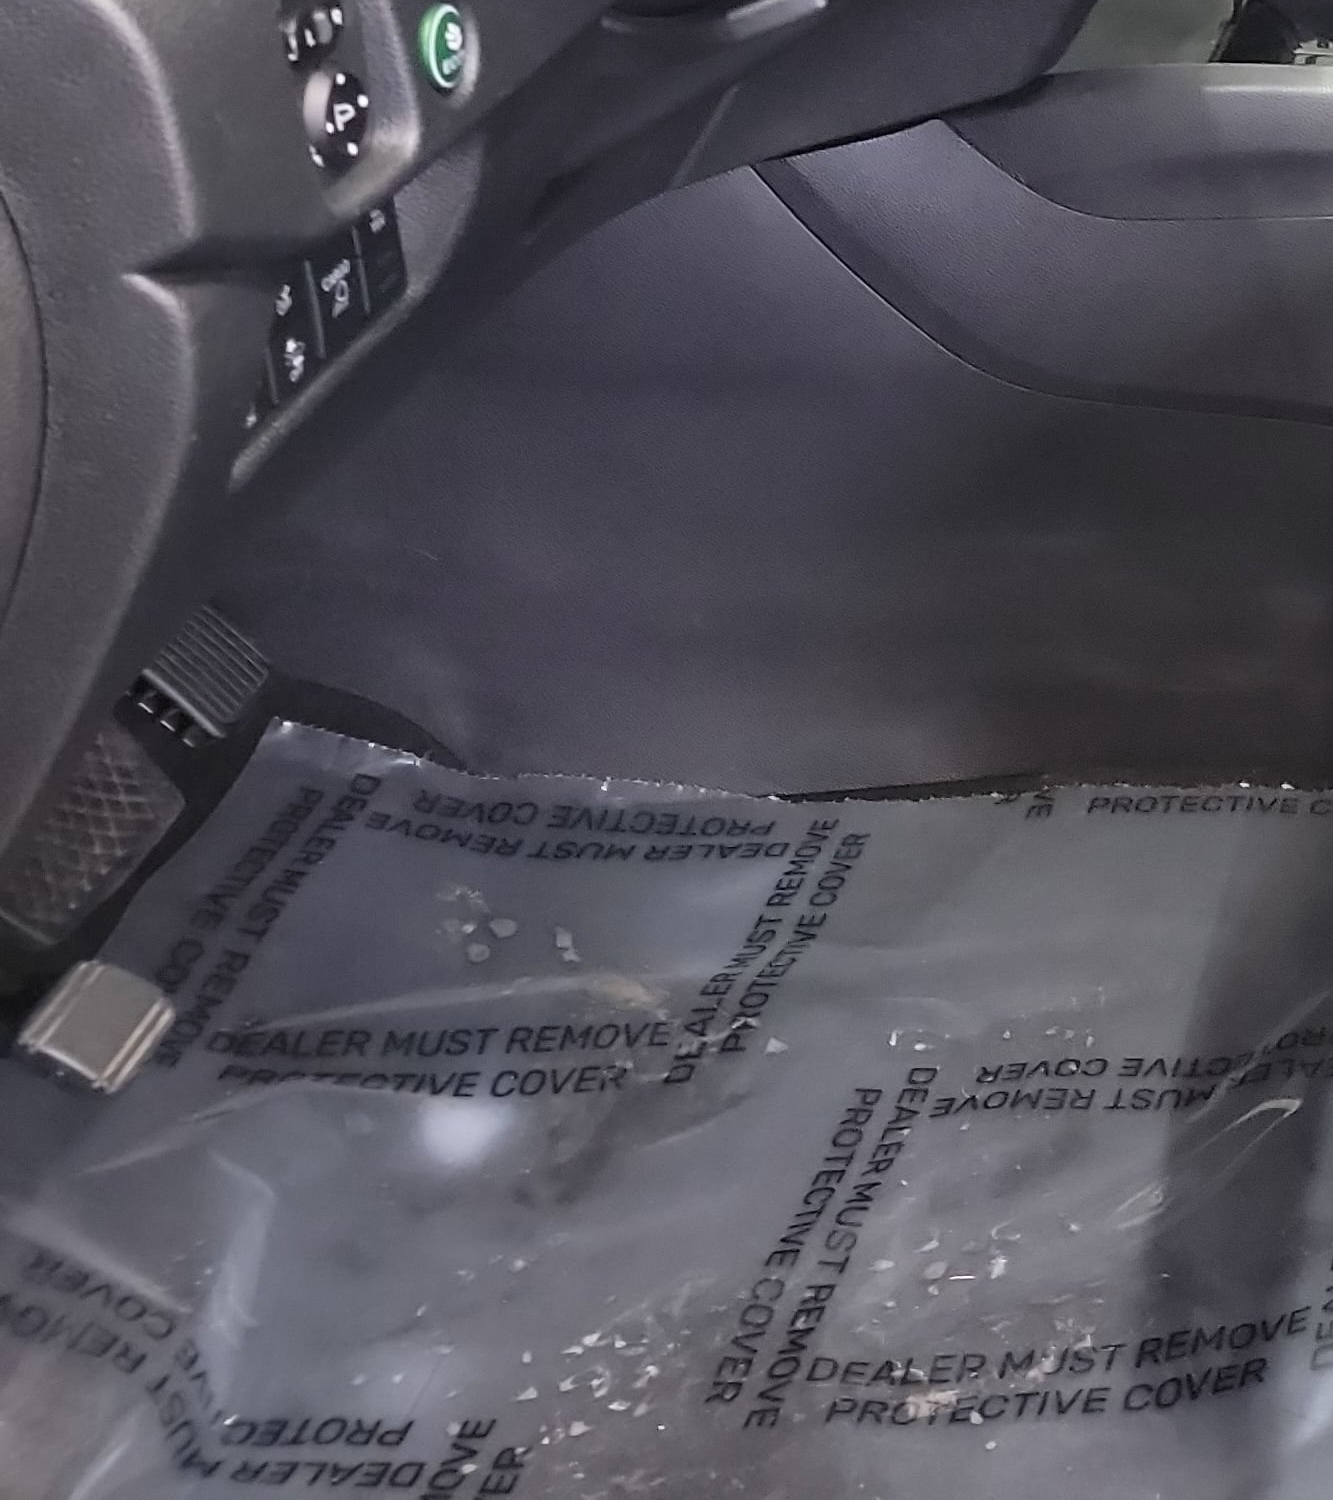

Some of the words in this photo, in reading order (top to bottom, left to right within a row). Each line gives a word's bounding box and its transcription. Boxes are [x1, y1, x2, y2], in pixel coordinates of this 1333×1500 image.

[292, 773, 381, 866] DEALER
[365, 812, 524, 856] REMOVE
[413, 789, 539, 825] COVER
[547, 804, 776, 837] PROTECTIVE
[1087, 796, 1298, 814] PROTECTIVE
[191, 787, 324, 929] PROTECTIVE
[526, 841, 636, 861] MUST
[643, 841, 790, 861] DEALER
[237, 869, 309, 943] MUST
[663, 971, 742, 1084] DEALER
[723, 914, 782, 969] MUST
[766, 818, 840, 907] REMOVE
[719, 913, 827, 1054] PROTECTIVE
[809, 833, 871, 907] COVER
[207, 1029, 371, 1057] DEALER
[382, 1028, 498, 1056] MUST
[505, 1022, 671, 1054] REMOVE
[976, 1058, 1108, 1083] COVER
[490, 1065, 628, 1097] COVER
[929, 1088, 1095, 1118] REMOVE
[1103, 1084, 1217, 1110] MUST
[861, 1067, 937, 1176] DEALER
[764, 1088, 883, 1267] PROTECTIVE
[817, 1181, 882, 1274] MUST
[0, 1293, 146, 1375] REMO
[704, 1277, 785, 1404] COVER
[742, 1283, 837, 1428] REMOVE
[806, 1353, 986, 1386] DEALER
[998, 1343, 1127, 1380] MUST
[1134, 1305, 1312, 1369] REMOVE
[824, 1387, 1111, 1425] PROTECTIVE
[1123, 1357, 1267, 1411] COVER
[230, 1460, 426, 1488] DEALER
[421, 1419, 497, 1500] OVE
